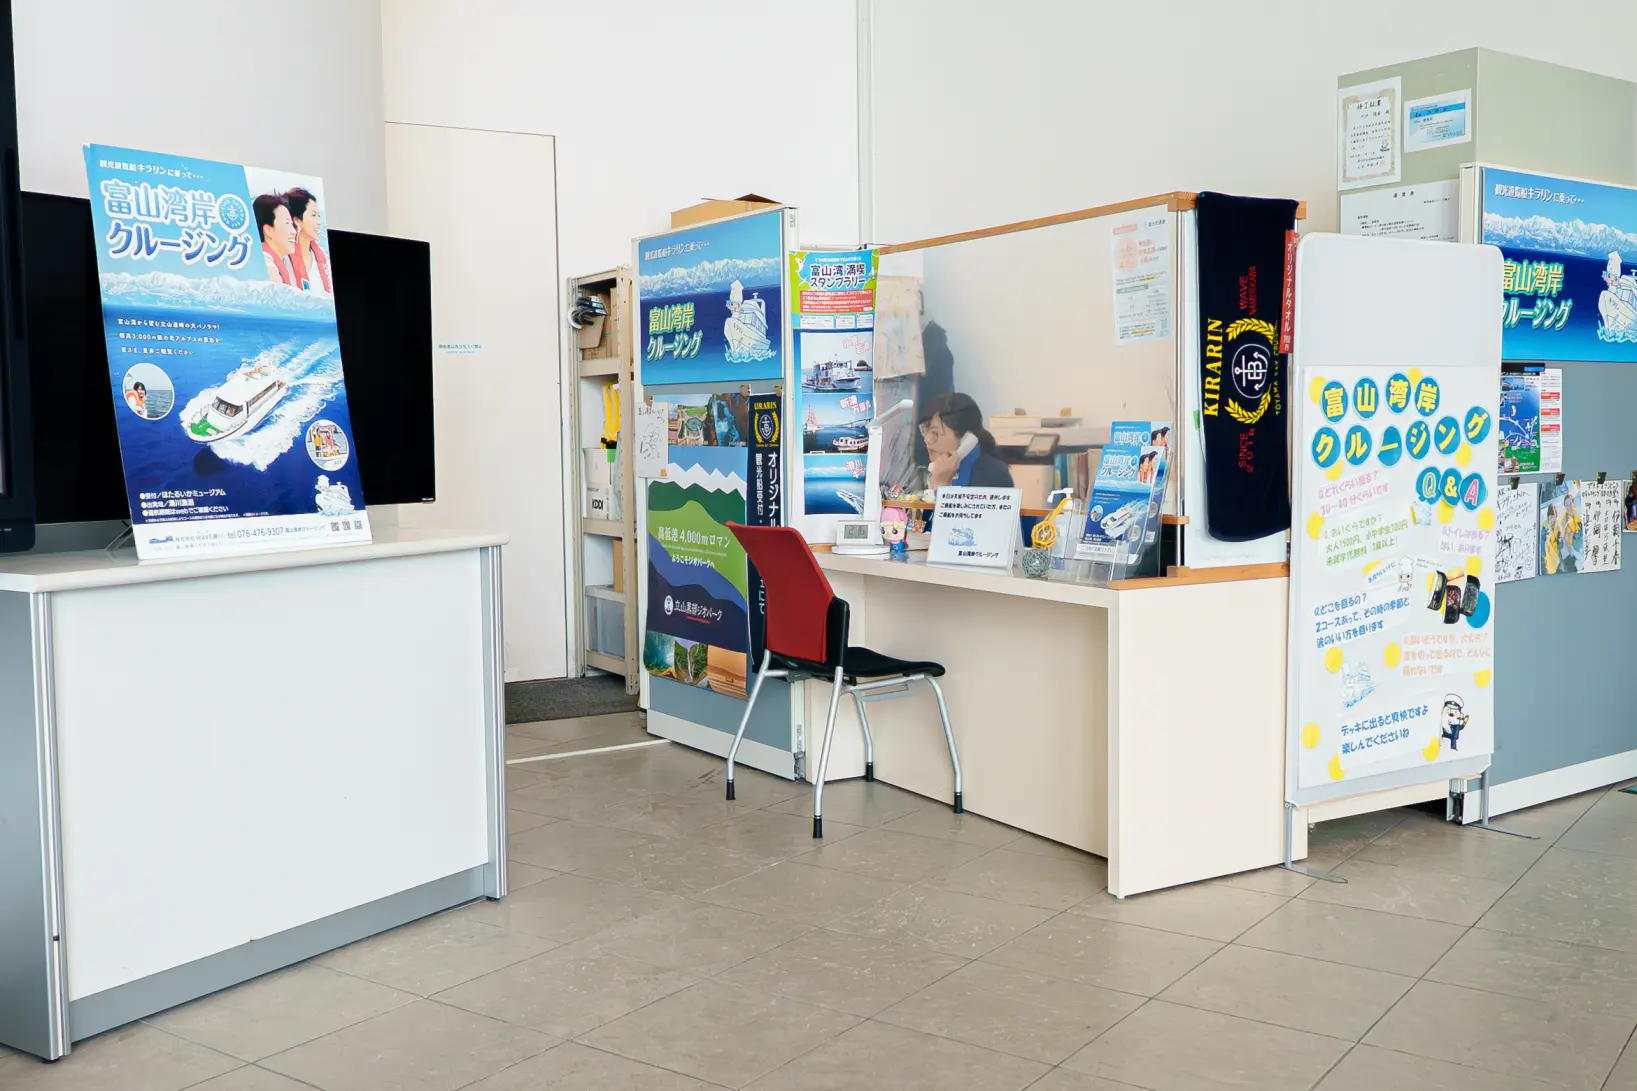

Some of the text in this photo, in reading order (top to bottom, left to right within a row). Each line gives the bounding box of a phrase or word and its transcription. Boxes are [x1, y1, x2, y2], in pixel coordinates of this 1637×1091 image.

[103, 180, 217, 228] 富山湾岸
[108, 221, 252, 269] クルージング
[810, 263, 866, 276] 富山湾 満喫
[810, 276, 866, 288] スタンプラリー
[1503, 260, 1564, 295] 富山湾岸
[1239, 274, 1249, 310] WAVE
[648, 301, 696, 334] 富山湾岸
[646, 329, 704, 361] クルージング
[1203, 317, 1224, 417] KIRARIN
[1274, 380, 1282, 416] TOYAMA
[1323, 378, 1438, 419] 富山湾岸
[1238, 430, 1249, 469] SINCE
[1315, 411, 1489, 463] クルージング
[1421, 472, 1479, 505] Q&A
[671, 553, 716, 569] ようこそジオパークへ
[957, 550, 999, 559] 富山湾岸クルージング
[674, 600, 723, 621] 立山黒部ジオパーク
[1341, 704, 1429, 737] デッキに出ると爽快ですよ
[1341, 727, 1411, 755] 楽しんでくださいね
